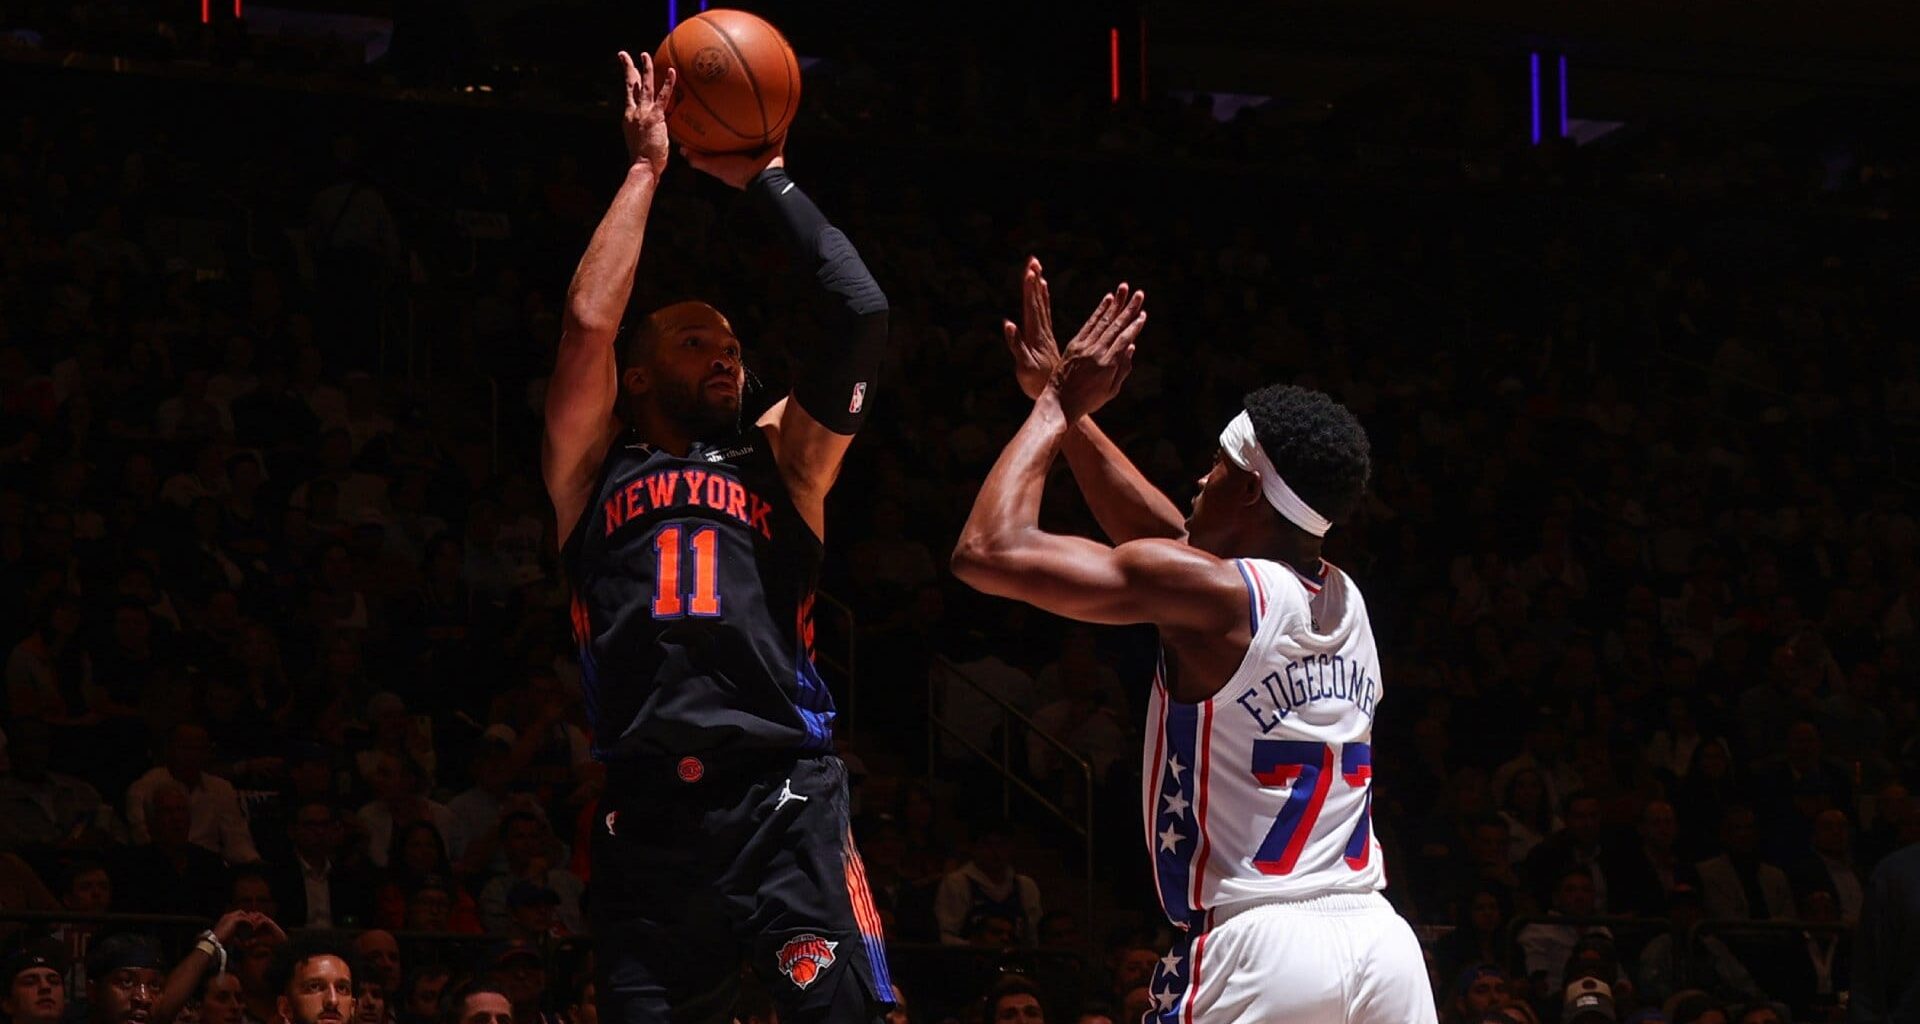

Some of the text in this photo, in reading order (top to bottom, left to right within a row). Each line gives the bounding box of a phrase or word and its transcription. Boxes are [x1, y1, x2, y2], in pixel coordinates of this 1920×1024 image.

[602, 468, 774, 541] NEW YORK
[651, 522, 723, 620] 11
